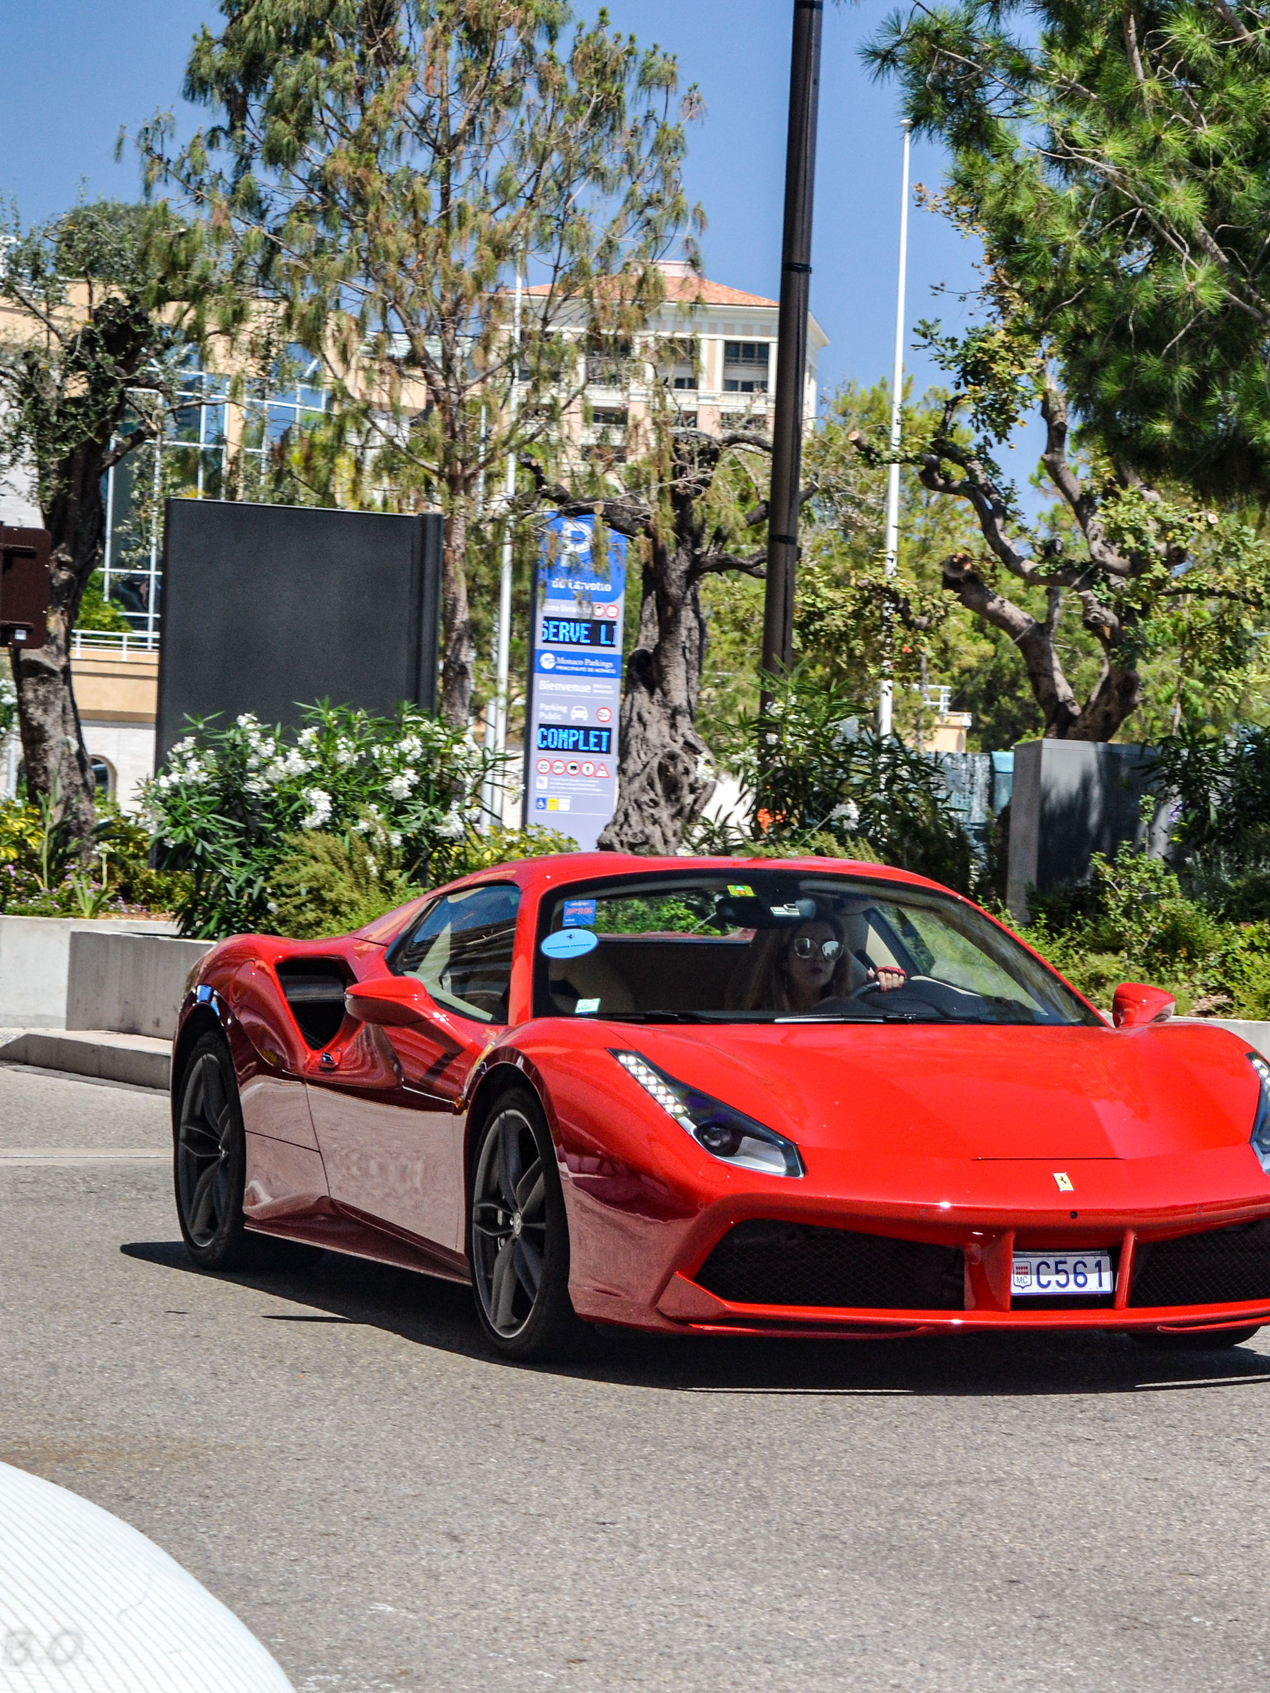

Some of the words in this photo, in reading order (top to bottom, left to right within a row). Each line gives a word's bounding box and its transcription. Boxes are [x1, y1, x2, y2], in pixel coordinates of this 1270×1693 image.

[556, 656, 584, 666] Monaco
[584, 658, 614, 669] Parkings
[538, 680, 591, 693] Bienvenue
[539, 703, 568, 714] Parking
[538, 711, 563, 721] Public
[537, 727, 610, 752] COMPLET
[1016, 1276, 1028, 1284] MC
[1036, 1260, 1102, 1289] C561
